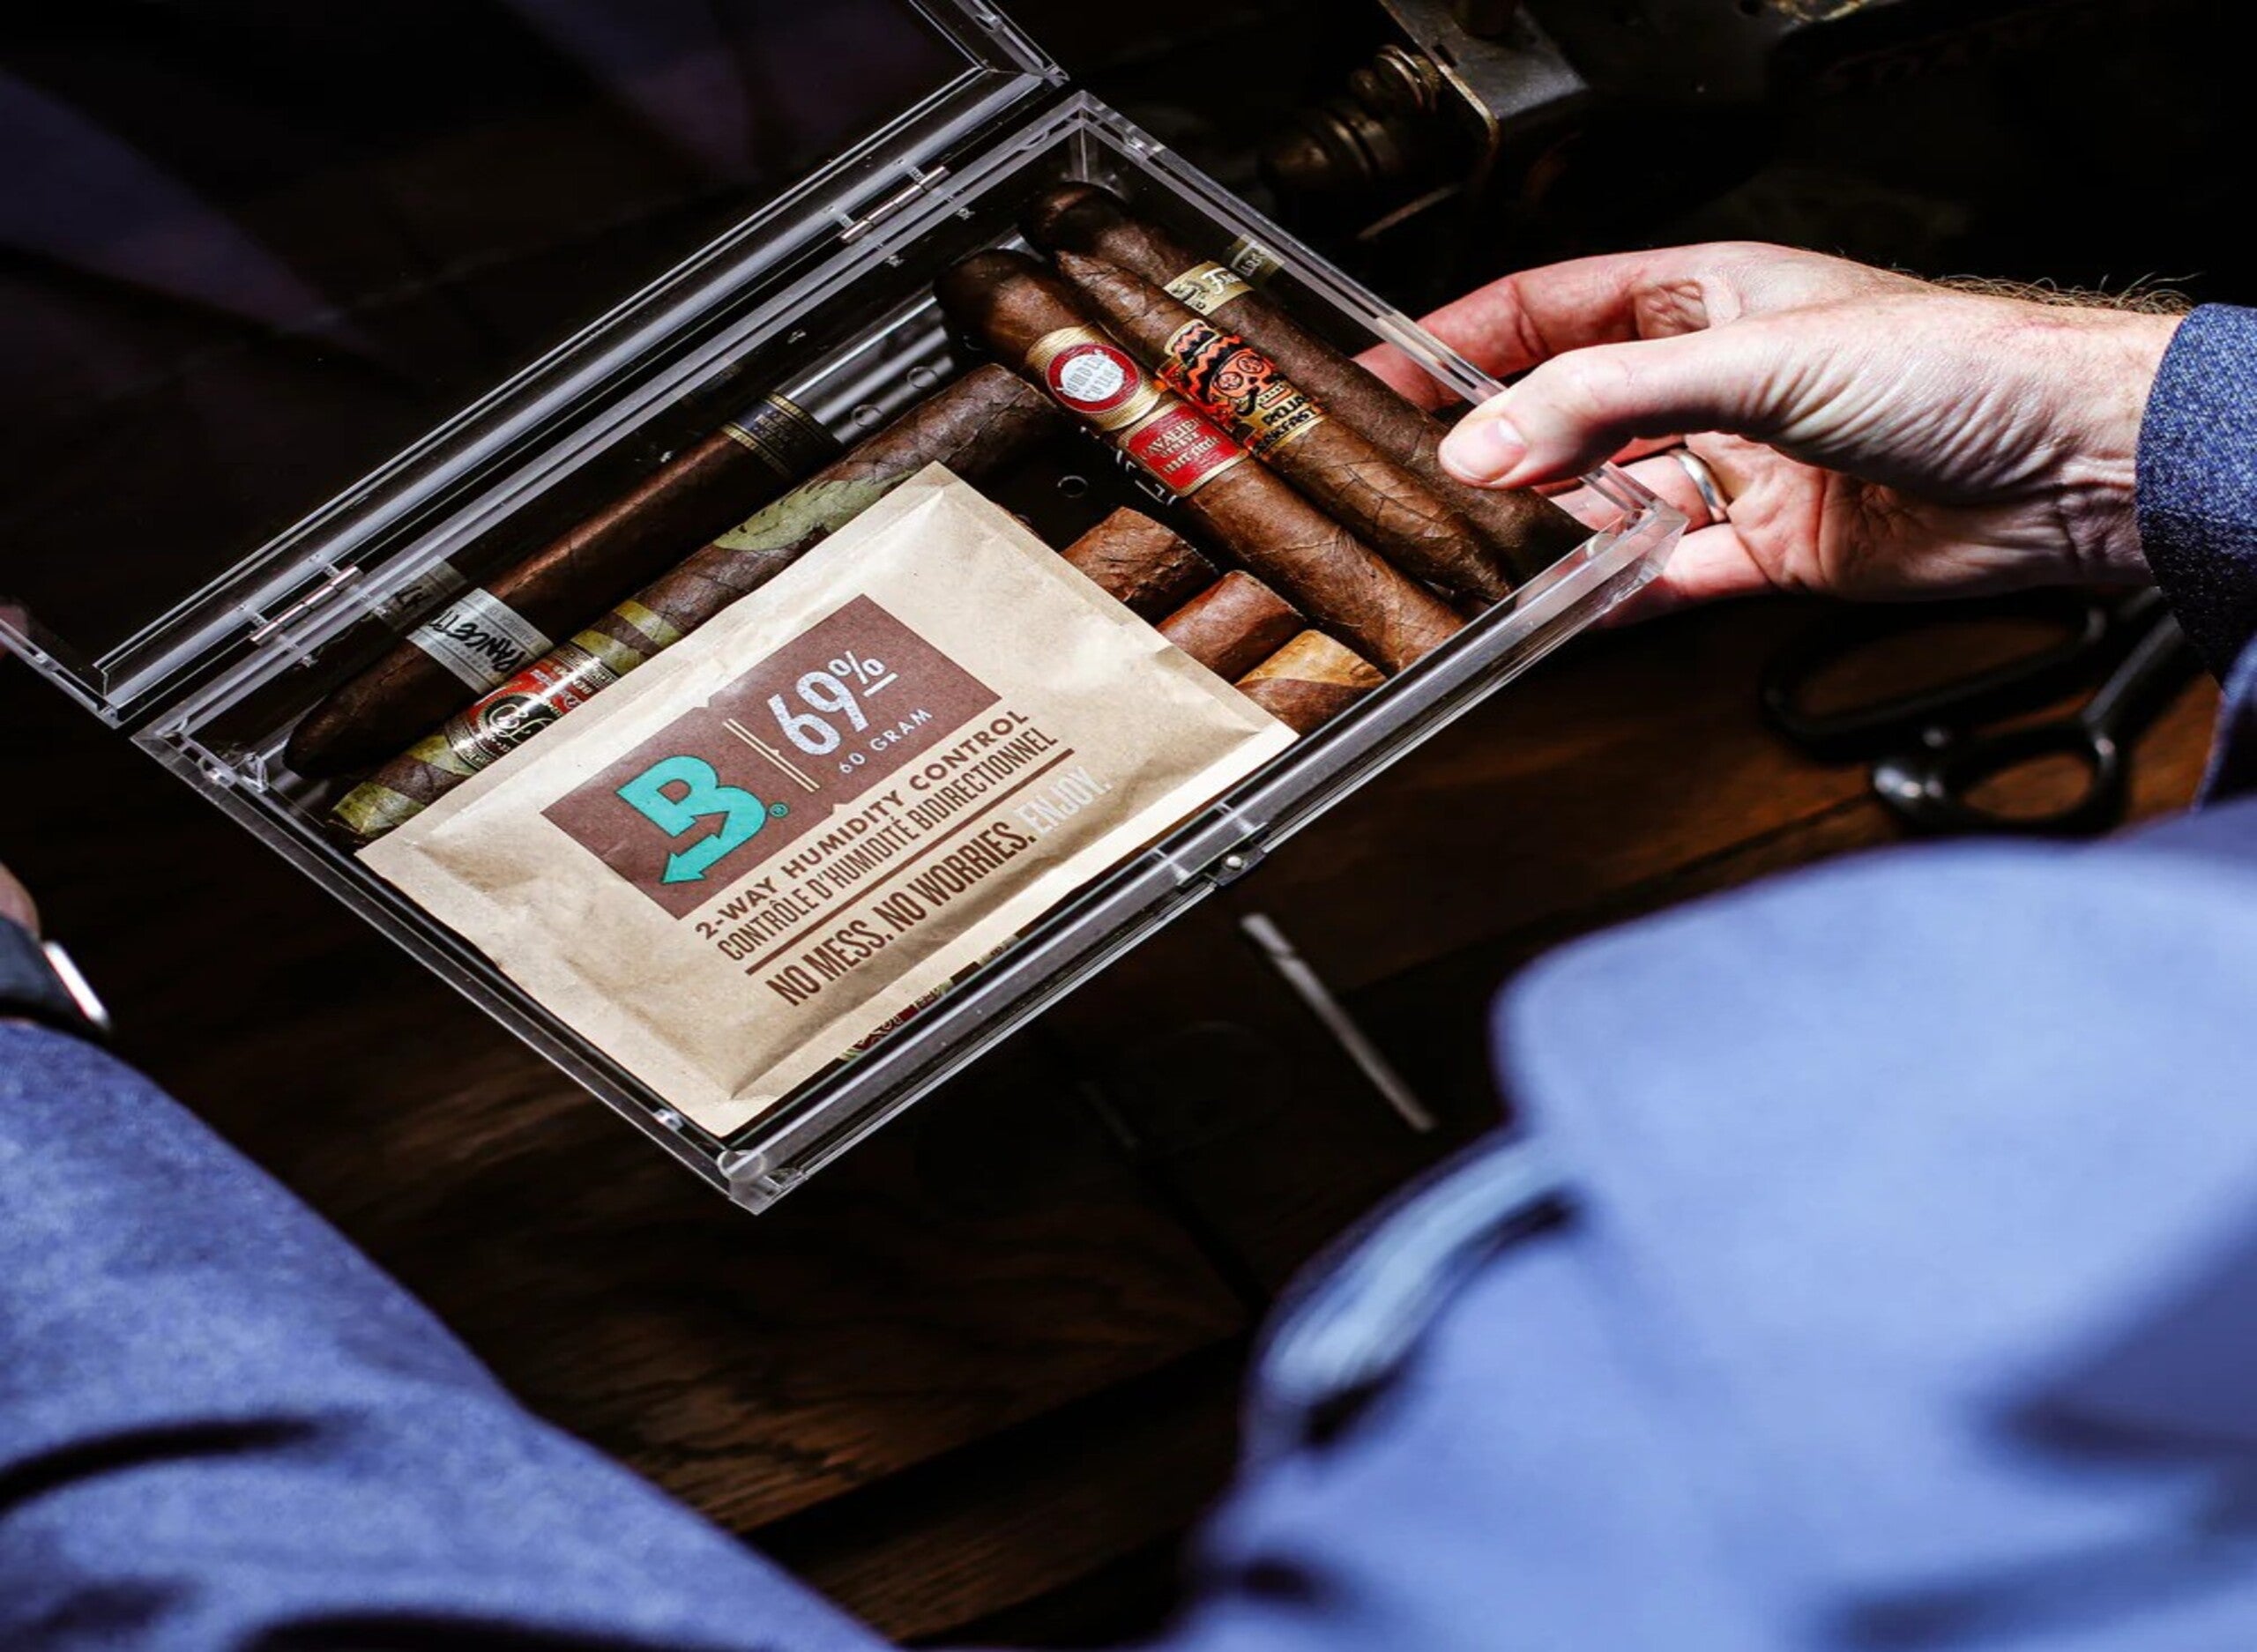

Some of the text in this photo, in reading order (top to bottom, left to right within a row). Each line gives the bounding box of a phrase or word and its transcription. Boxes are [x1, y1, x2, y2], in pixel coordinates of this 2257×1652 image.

[767, 651, 885, 755] 69%
[839, 708, 933, 774] 60 GRAM
[695, 711, 1029, 940] 2-WAY HUMIDITY CONTROL
[717, 727, 1059, 961] CONTRÔLE D'HUMIDITÉ BIDIRECTIONNEL
[764, 765, 1114, 1007] NO MESS. NO WORRIES. ENJOY.
